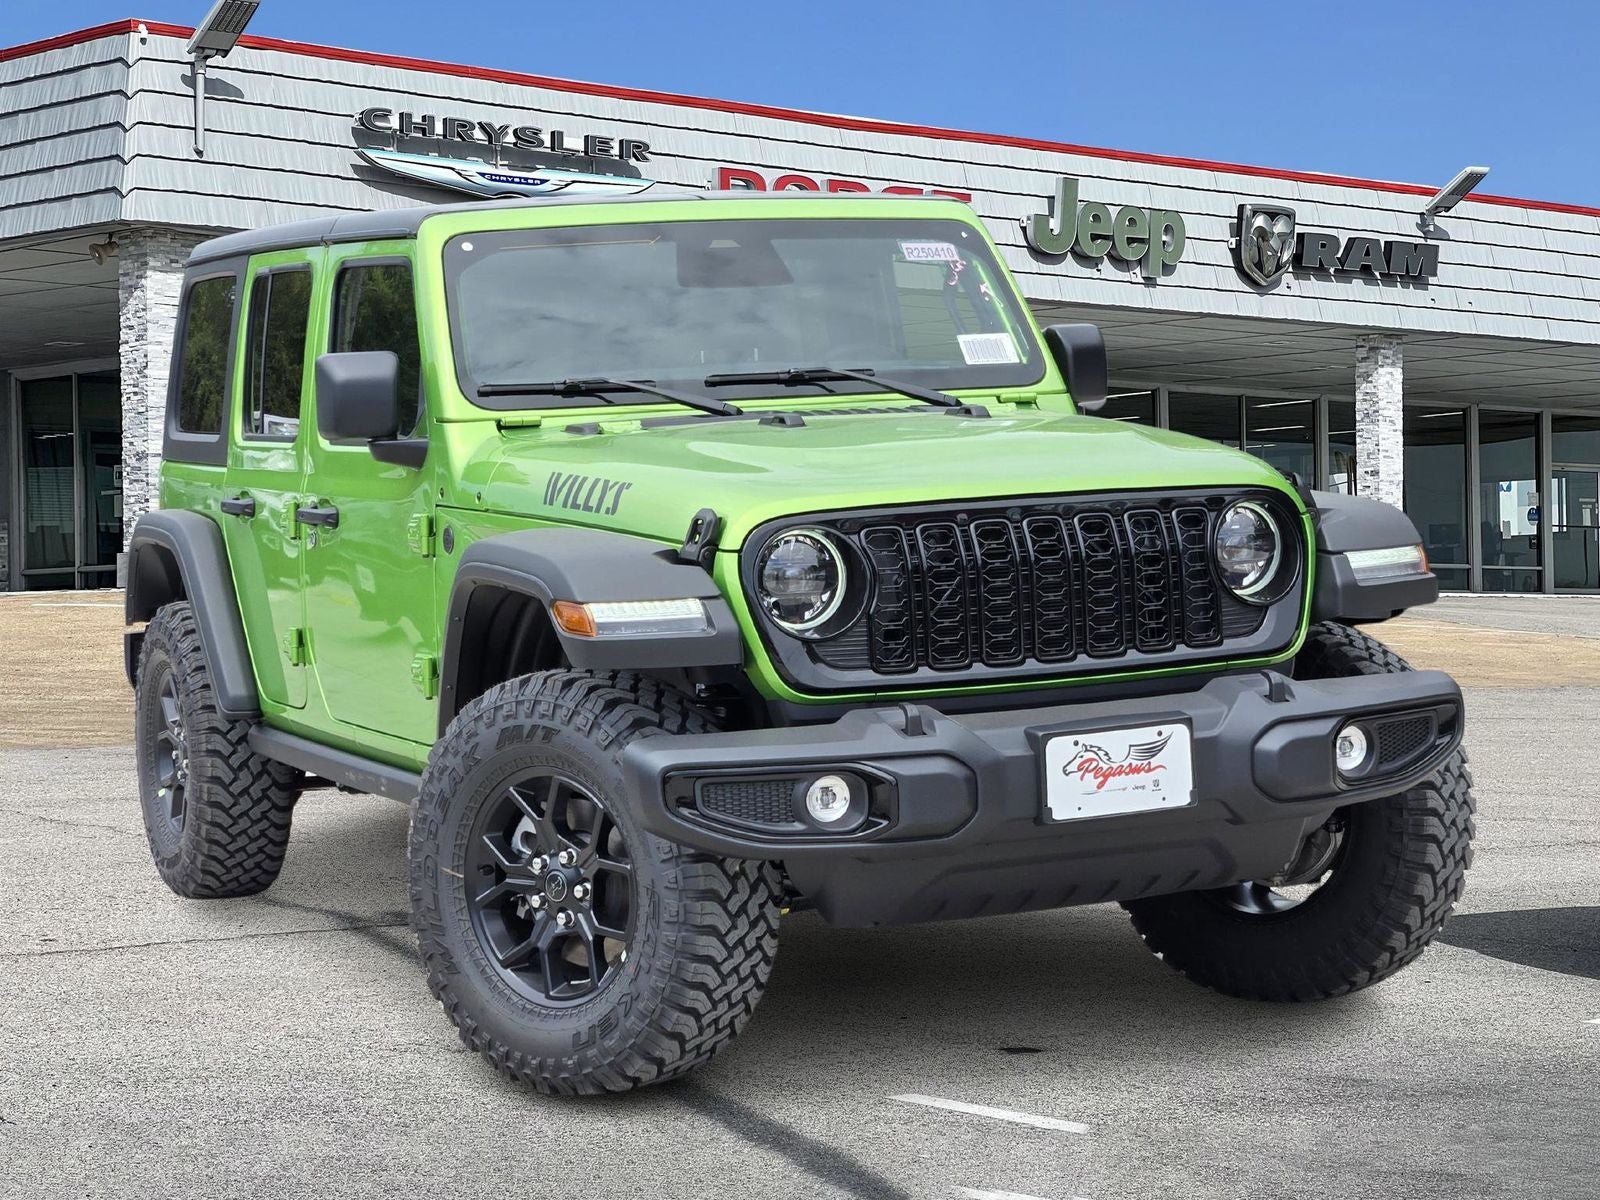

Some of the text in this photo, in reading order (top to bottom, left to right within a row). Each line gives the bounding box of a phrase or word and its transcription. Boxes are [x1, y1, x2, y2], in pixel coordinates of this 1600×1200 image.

[355, 107, 650, 162] CHRYSLER
[484, 174, 541, 185] CHRYSLER
[1026, 177, 1186, 278] Jeep
[905, 247, 955, 259] R250410
[1299, 232, 1439, 277] RAM
[543, 471, 633, 516] WILLYS
[496, 724, 560, 750] M/T
[1076, 757, 1167, 790] Pegasus
